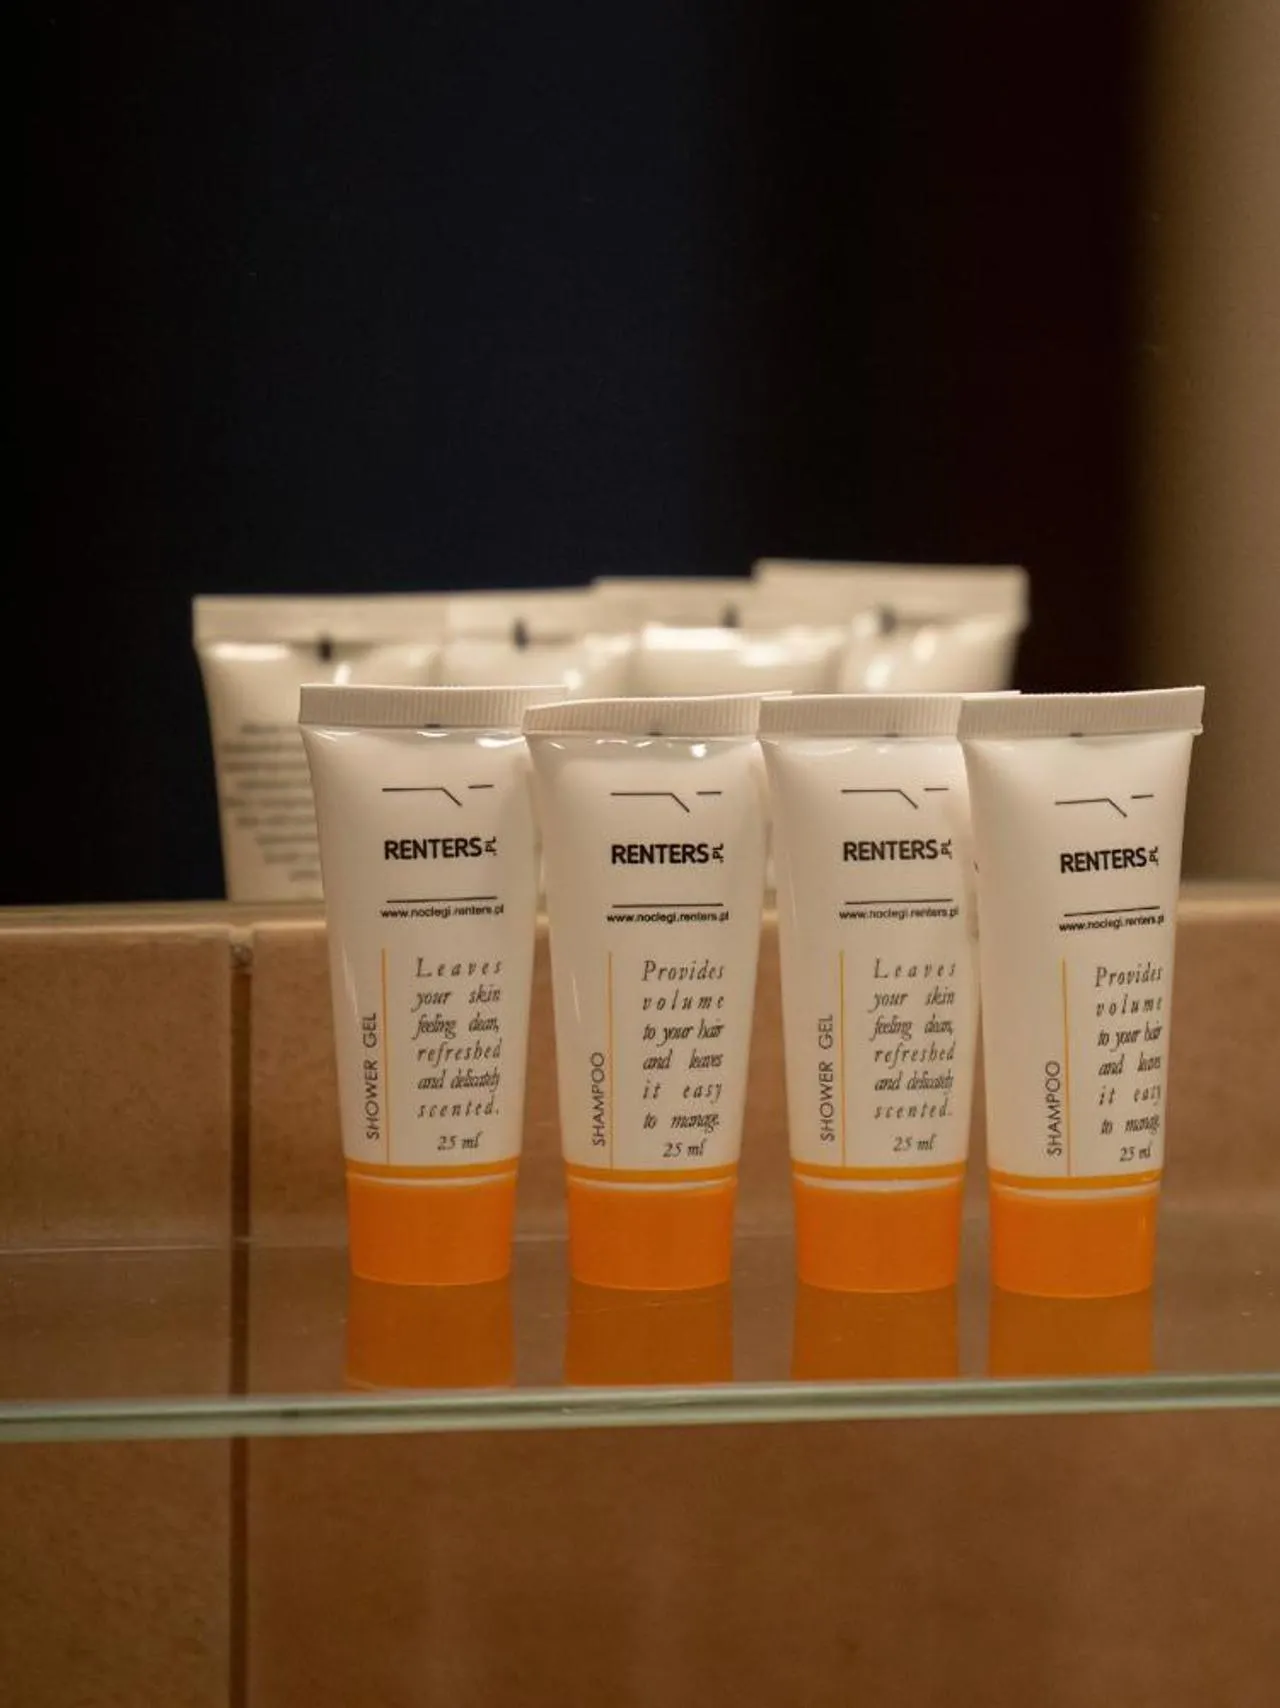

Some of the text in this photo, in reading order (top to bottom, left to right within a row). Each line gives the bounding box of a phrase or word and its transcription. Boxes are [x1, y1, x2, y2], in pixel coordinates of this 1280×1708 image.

[384, 837, 483, 861] RENTERS
[611, 843, 709, 865] RENTERS
[843, 839, 938, 862] RENTERS
[1060, 847, 1147, 874] RENTERS
[380, 904, 504, 919] www.noclegi.renters.pl
[606, 911, 729, 924] www.noclegi.renters.pl
[839, 906, 959, 920] www.noclegi.renters.pl
[416, 956, 502, 978] Leaves
[641, 959, 724, 982] Provides
[874, 957, 955, 979] Leaves
[411, 984, 501, 1013] your skin
[642, 989, 724, 1010] volume
[867, 985, 955, 1013] your skin
[411, 1013, 457, 1040] feeling
[642, 1018, 724, 1047] to your hair
[868, 1014, 913, 1042] feeling
[417, 1038, 502, 1068] refreshed
[643, 1048, 724, 1070] and leaves
[874, 1041, 956, 1069] refreshed
[362, 1012, 380, 1140] SHOWER GEL
[417, 1068, 446, 1090] and
[818, 1014, 834, 1142] SHOWER GEL
[874, 1071, 902, 1091] and
[589, 1052, 605, 1147] SHAMPOO
[643, 1080, 722, 1104] it easy
[417, 1093, 499, 1118] scented.
[874, 1097, 953, 1119] scented.
[643, 1112, 658, 1129] to
[437, 1131, 484, 1151] 25 ml
[663, 1138, 707, 1157] 25 ml
[893, 1133, 937, 1151] 25 ml
